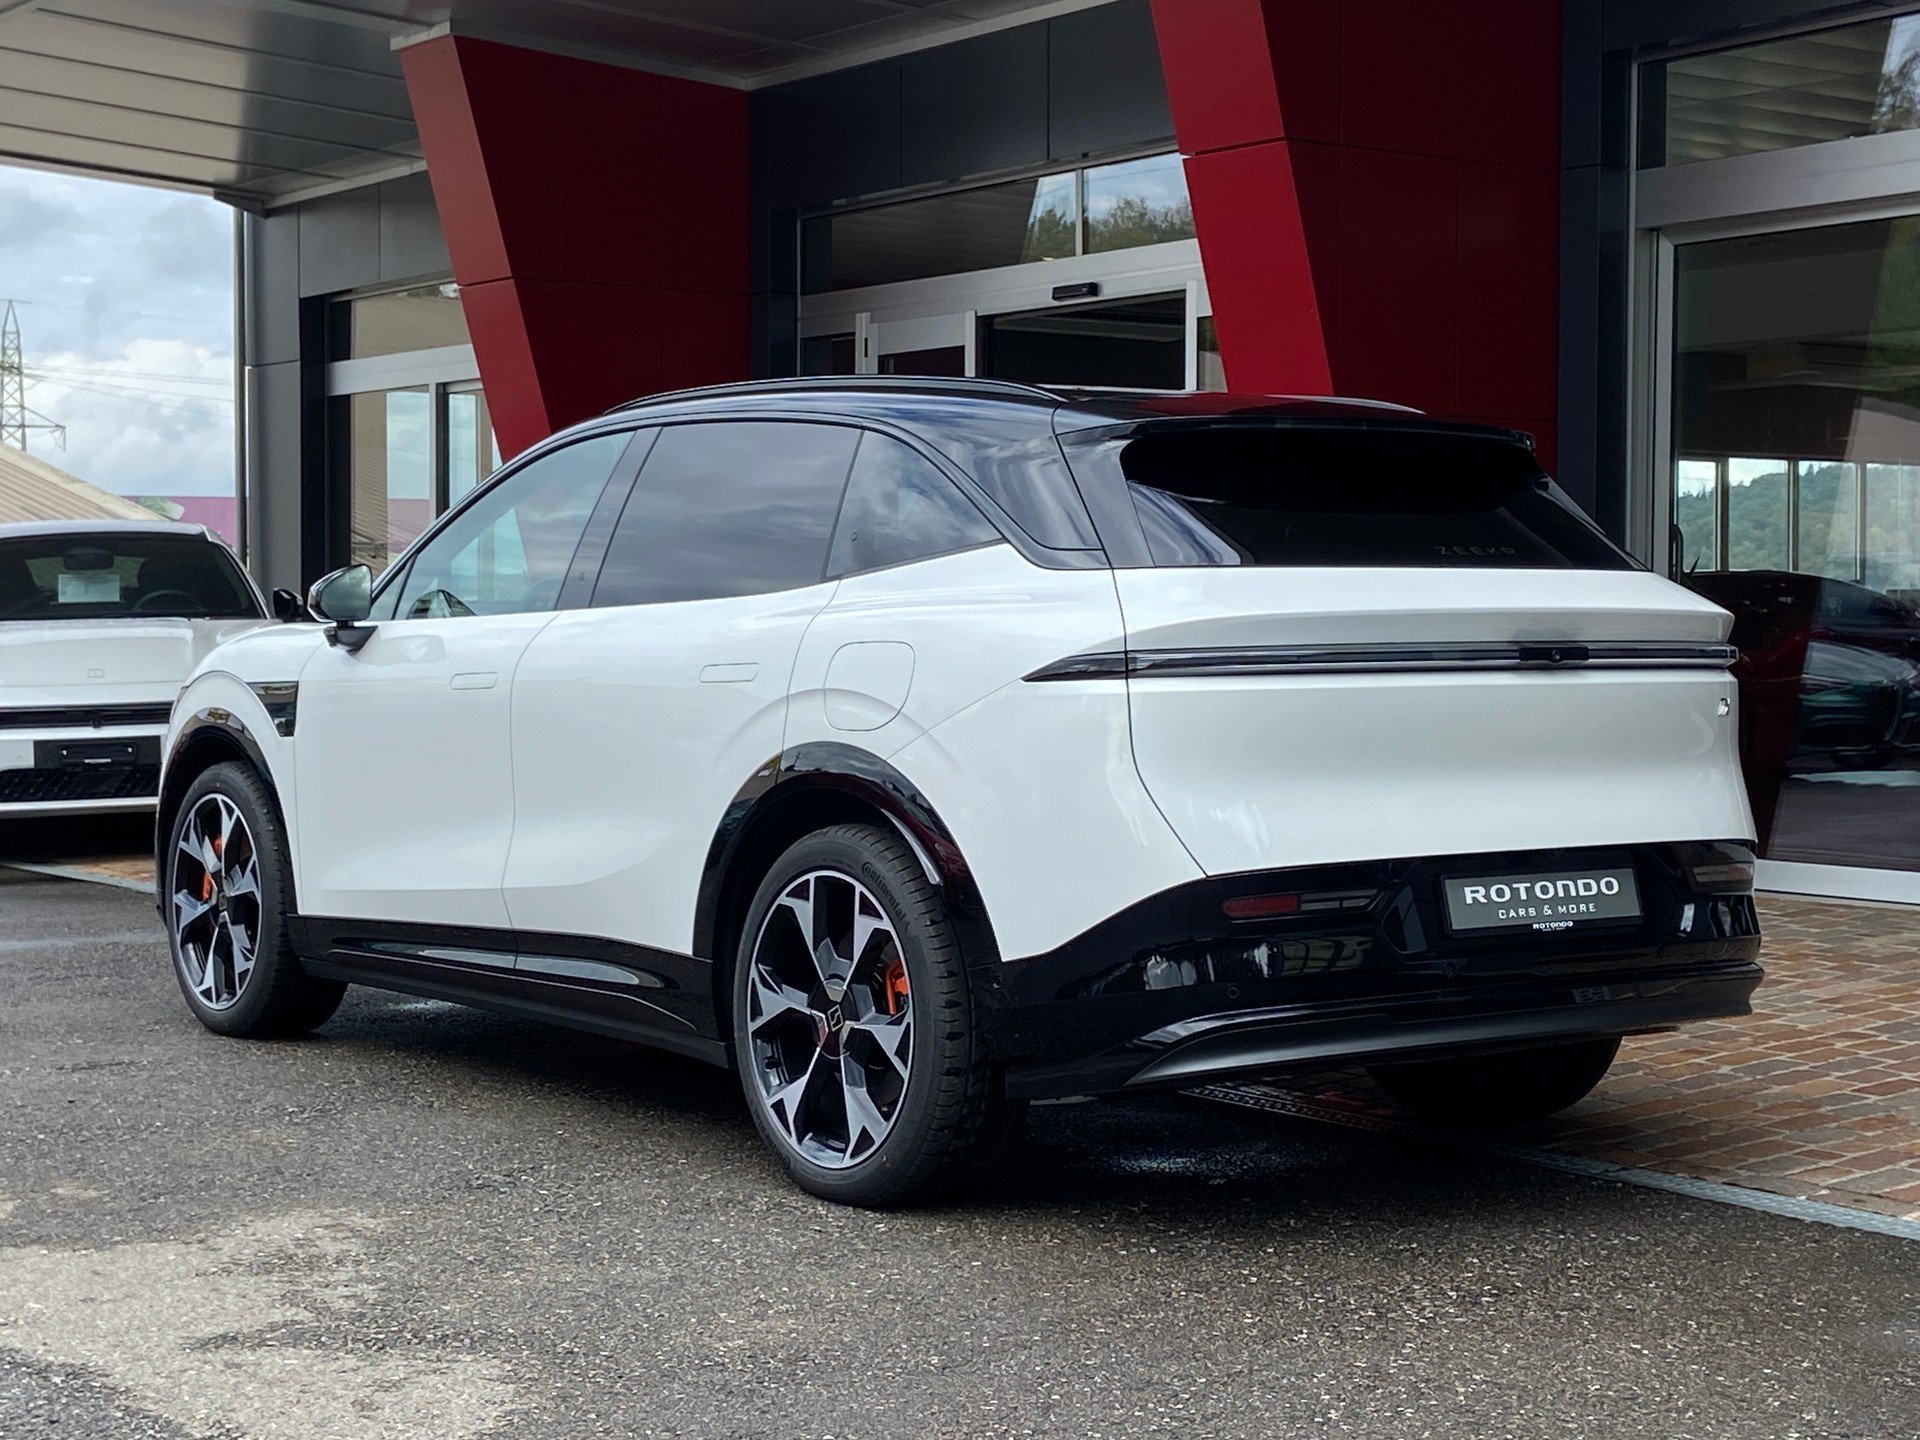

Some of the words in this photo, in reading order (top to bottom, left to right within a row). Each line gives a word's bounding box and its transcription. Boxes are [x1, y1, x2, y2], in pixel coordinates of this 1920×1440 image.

[861, 861, 906, 921] Continental
[1463, 876, 1620, 904] ROTONDO
[1498, 907, 1536, 919] CARS
[1543, 904, 1553, 916] &
[1558, 903, 1597, 914] MORE
